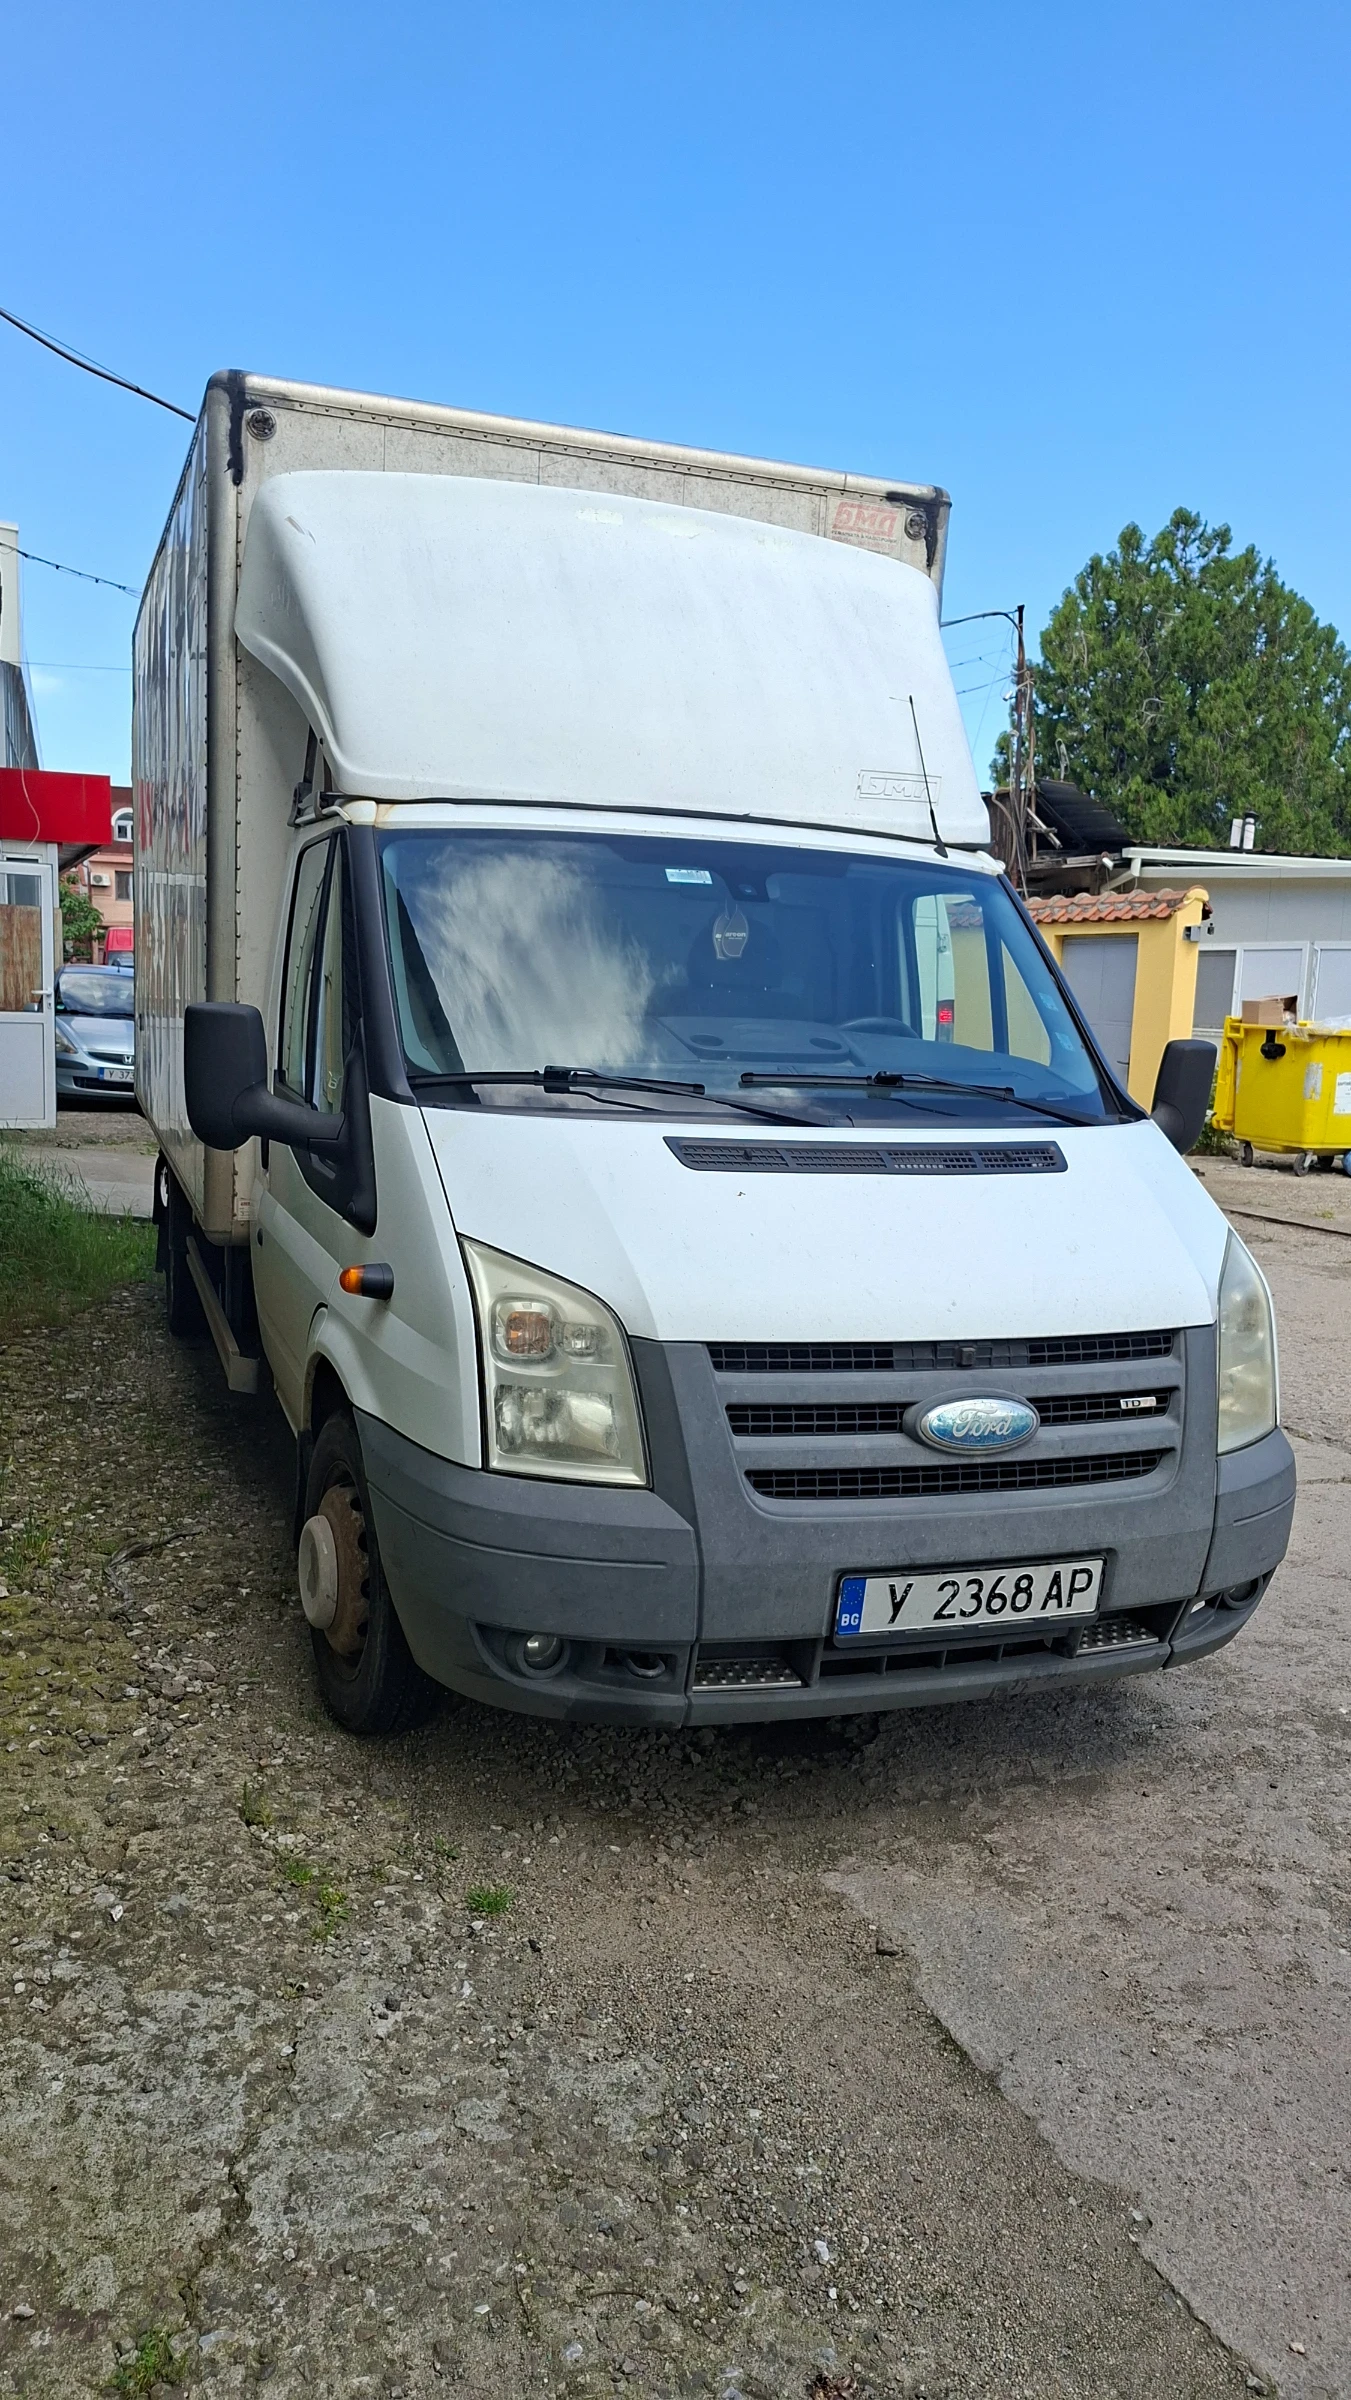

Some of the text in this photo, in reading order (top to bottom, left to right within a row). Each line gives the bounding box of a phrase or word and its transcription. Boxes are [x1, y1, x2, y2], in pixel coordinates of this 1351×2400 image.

[952, 1407, 1013, 1438] Ford
[932, 1573, 1034, 1621] 2368
[1040, 1567, 1094, 1611] AP
[840, 1613, 859, 1627] BG
